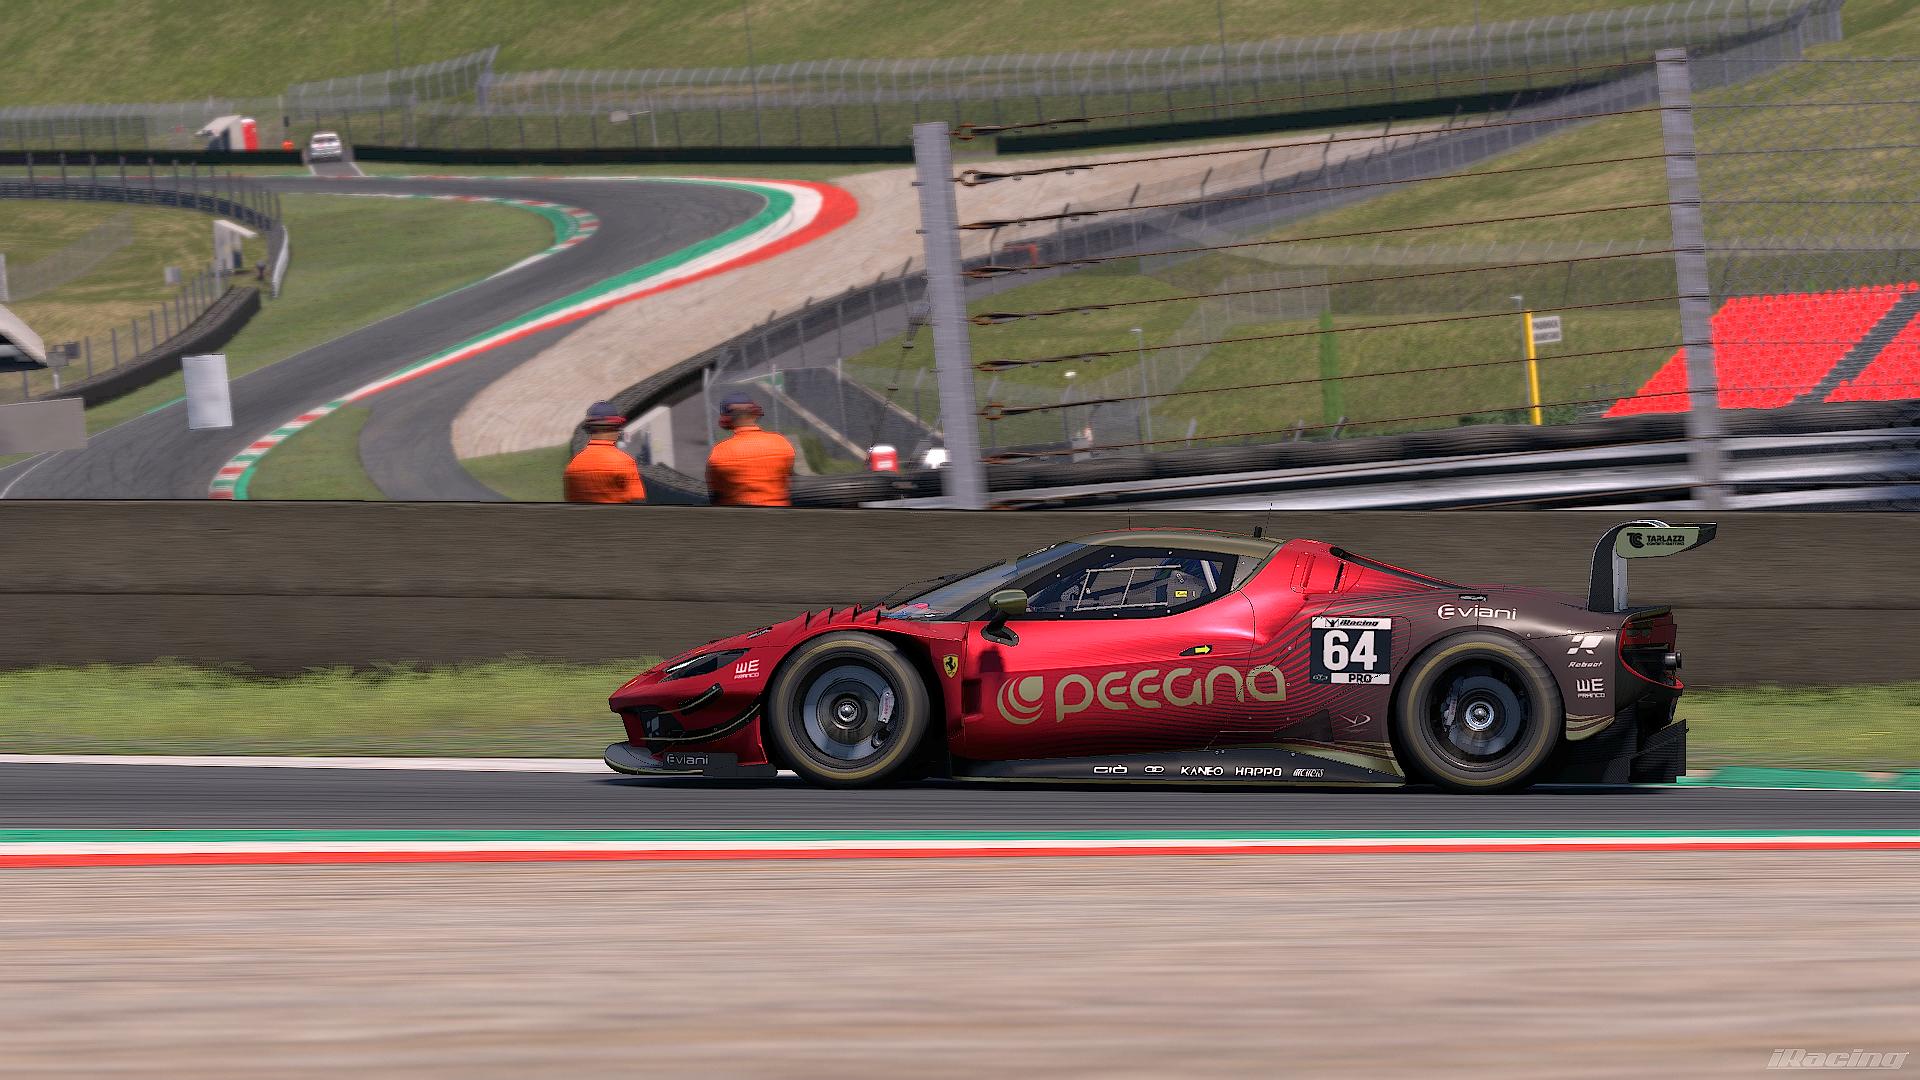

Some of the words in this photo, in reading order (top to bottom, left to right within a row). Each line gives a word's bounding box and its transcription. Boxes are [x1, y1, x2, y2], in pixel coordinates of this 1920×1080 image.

[1340, 619, 1379, 627] iRacing
[1323, 629, 1378, 671] 64
[1348, 673, 1372, 683] PRO
[1576, 678, 1604, 692] WE
[1180, 766, 1224, 776] KANEO
[1235, 766, 1283, 777] HAPPO
